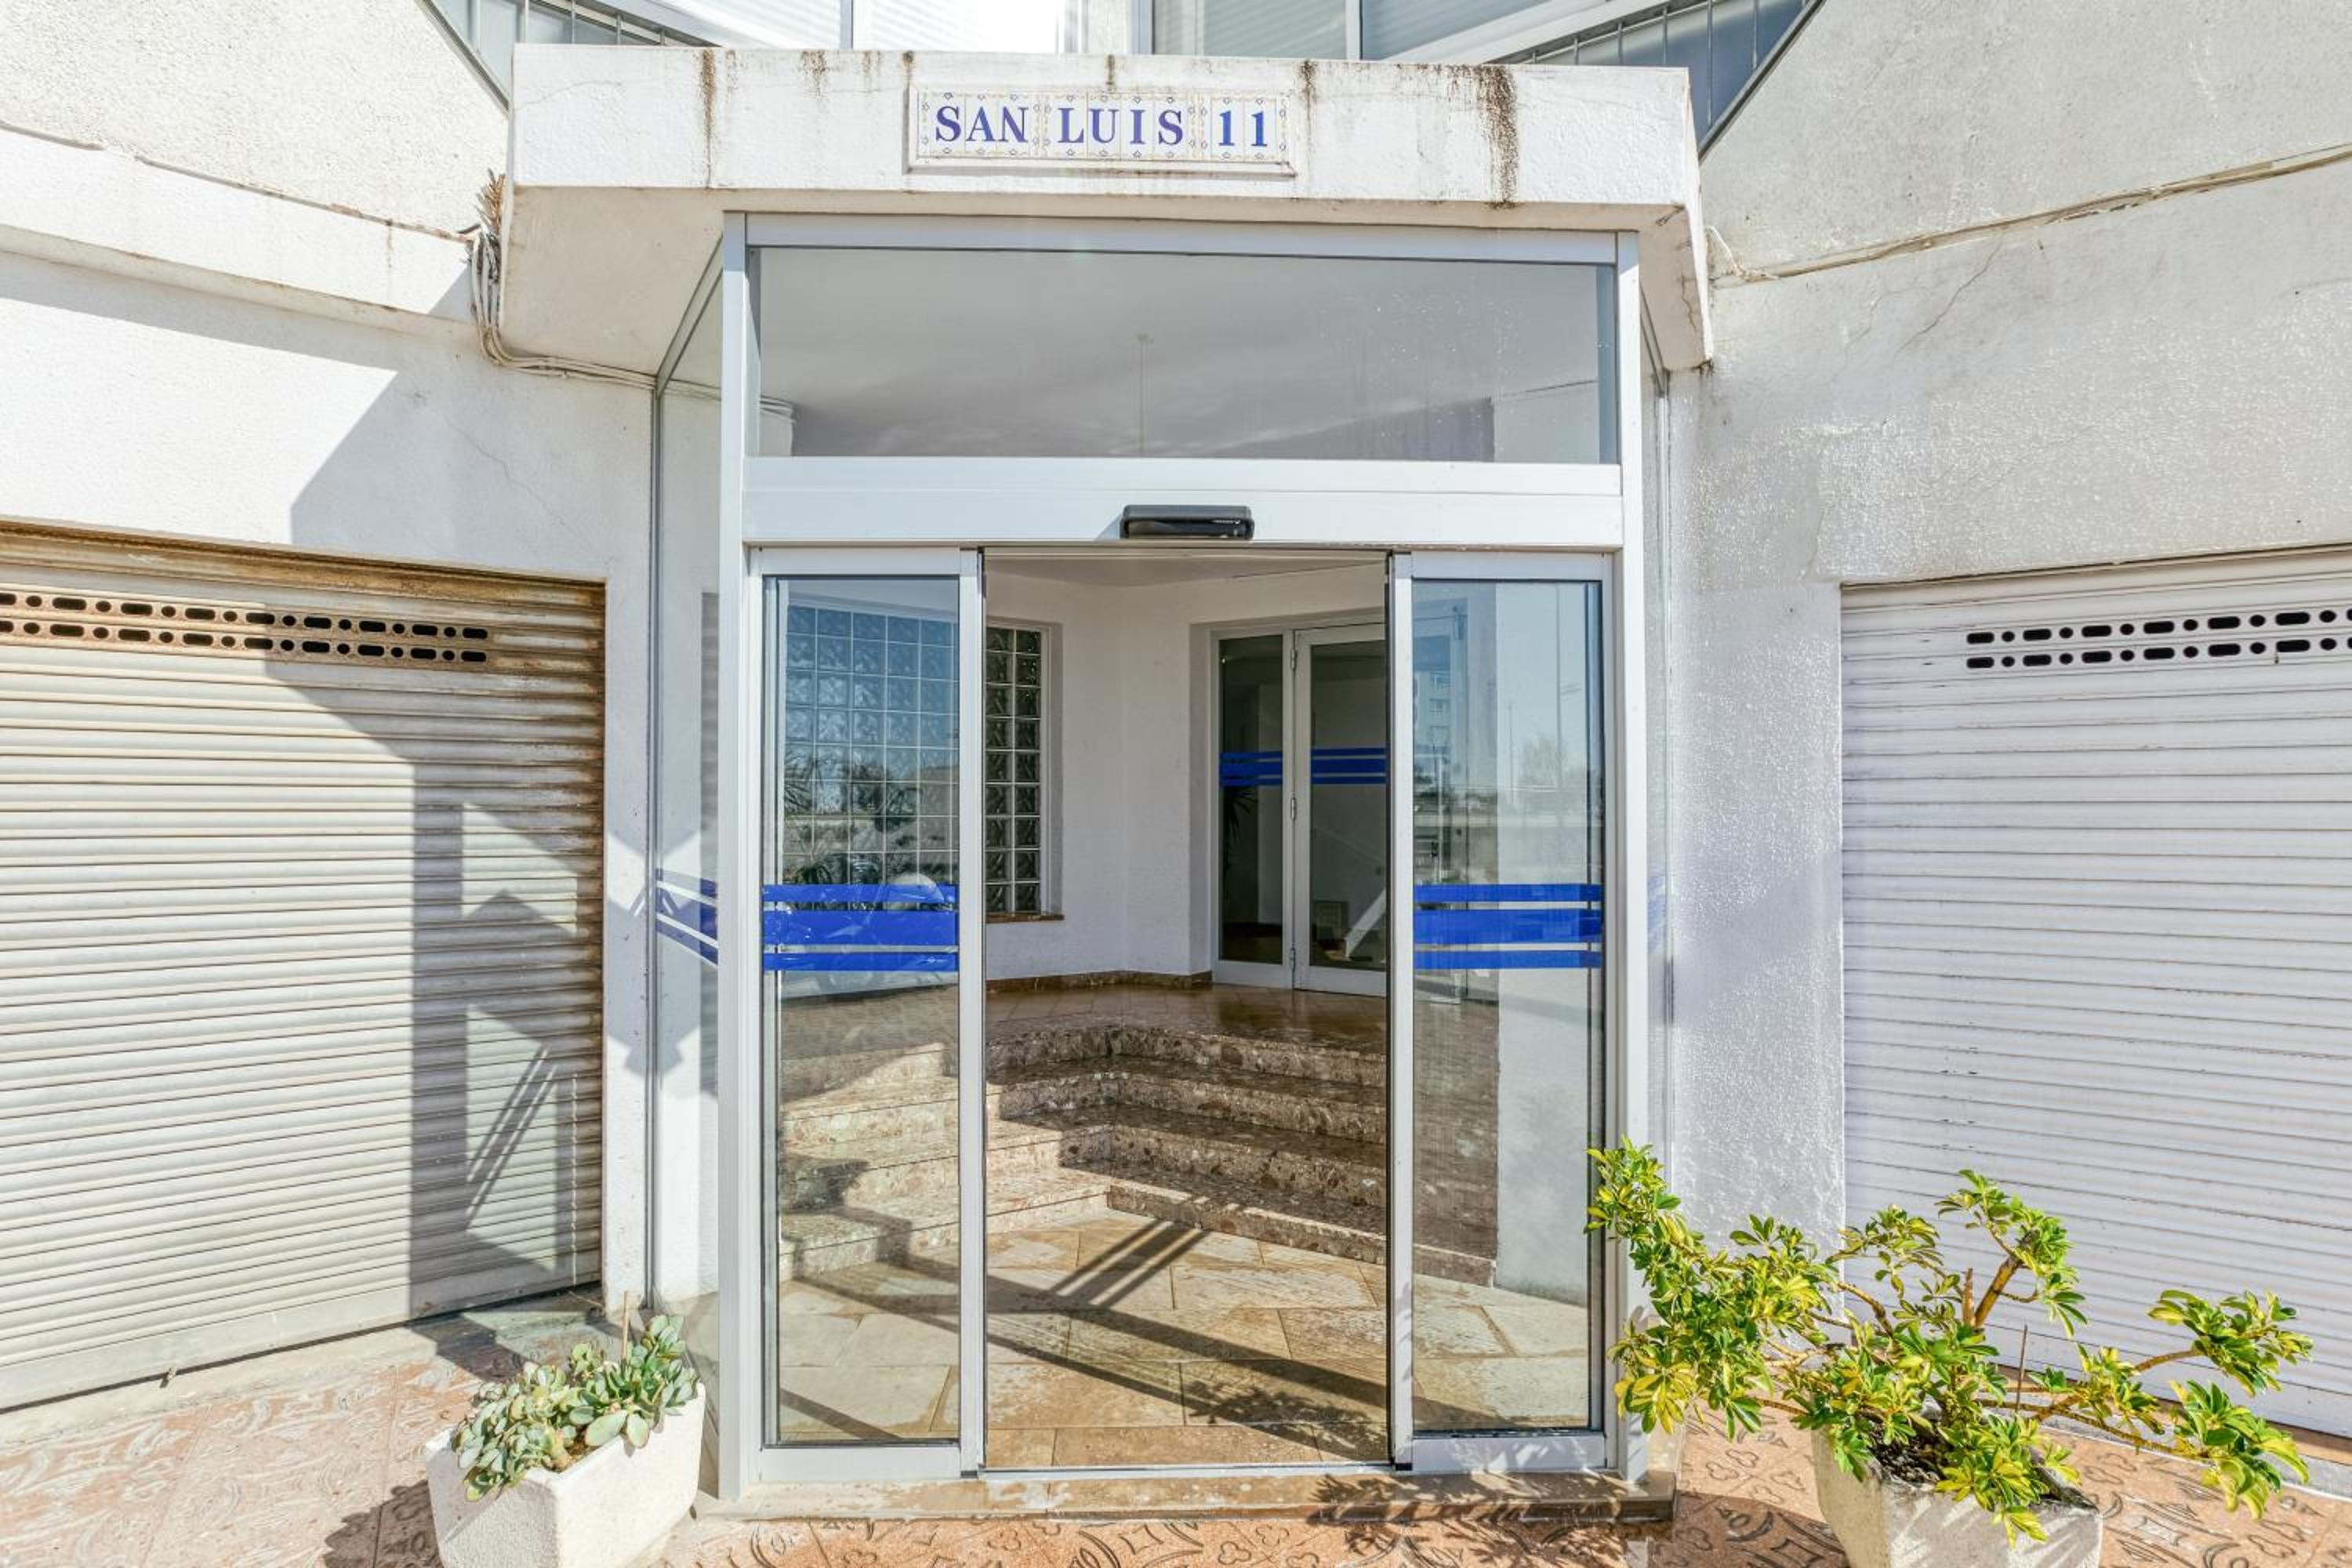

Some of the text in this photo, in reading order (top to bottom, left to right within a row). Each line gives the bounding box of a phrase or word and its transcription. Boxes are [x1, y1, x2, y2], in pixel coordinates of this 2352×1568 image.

[935, 106, 1268, 147] SAN LUIS 11
